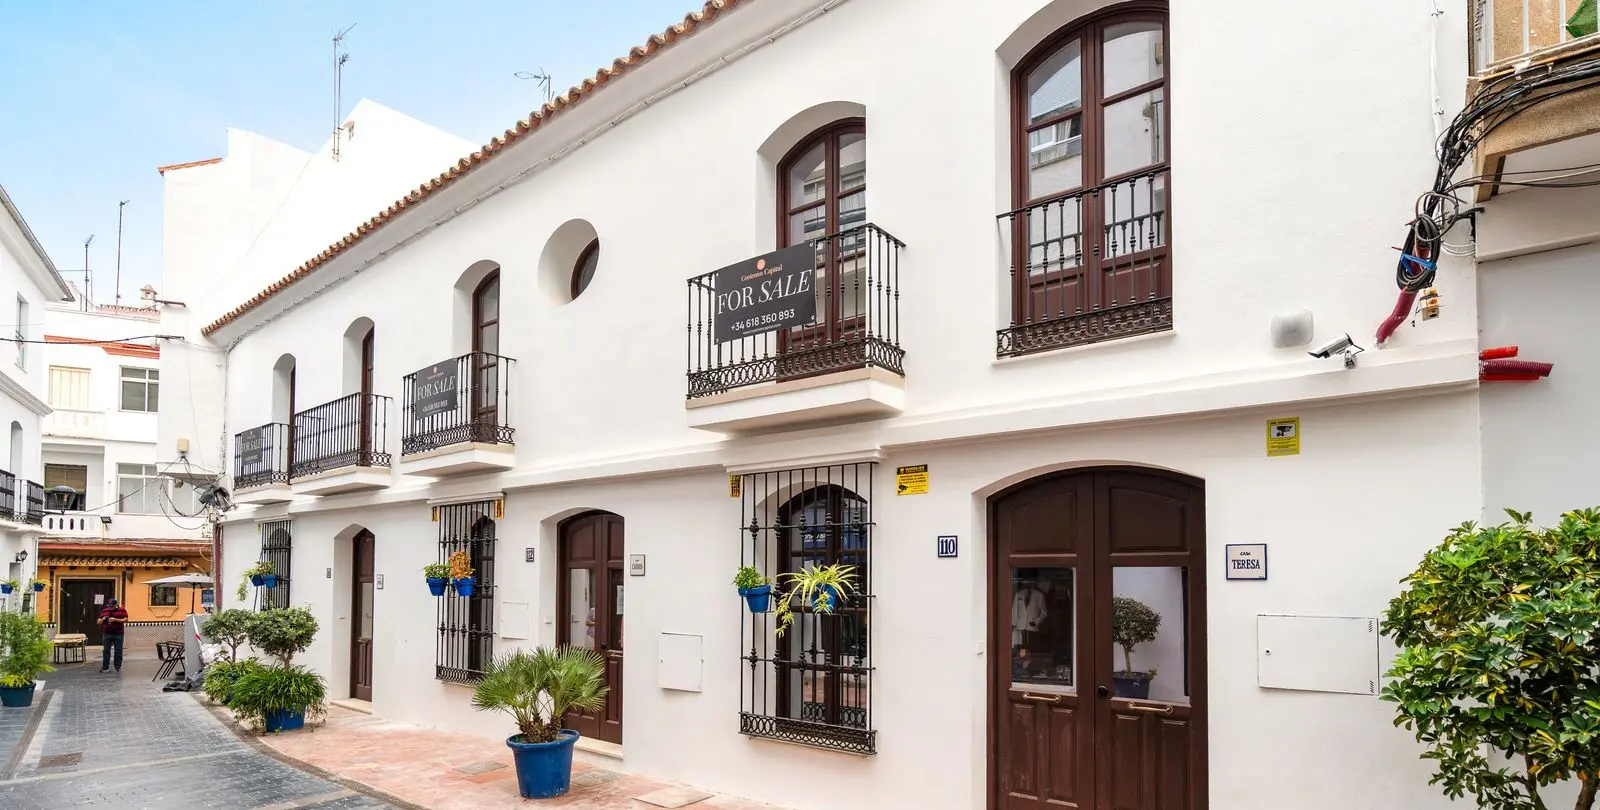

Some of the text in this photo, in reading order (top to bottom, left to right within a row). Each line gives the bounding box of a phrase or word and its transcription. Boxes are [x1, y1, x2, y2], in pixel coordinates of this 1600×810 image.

[764, 264, 783, 276] Capital
[717, 269, 813, 315] FOR SALE
[730, 321, 745, 331] +34
[746, 317, 760, 329] 618
[760, 312, 777, 325] 360
[778, 308, 795, 320] 893
[417, 383, 432, 401] FOR
[432, 375, 456, 395] SALE
[940, 538, 956, 555] 110
[1231, 559, 1261, 570] TERESA
